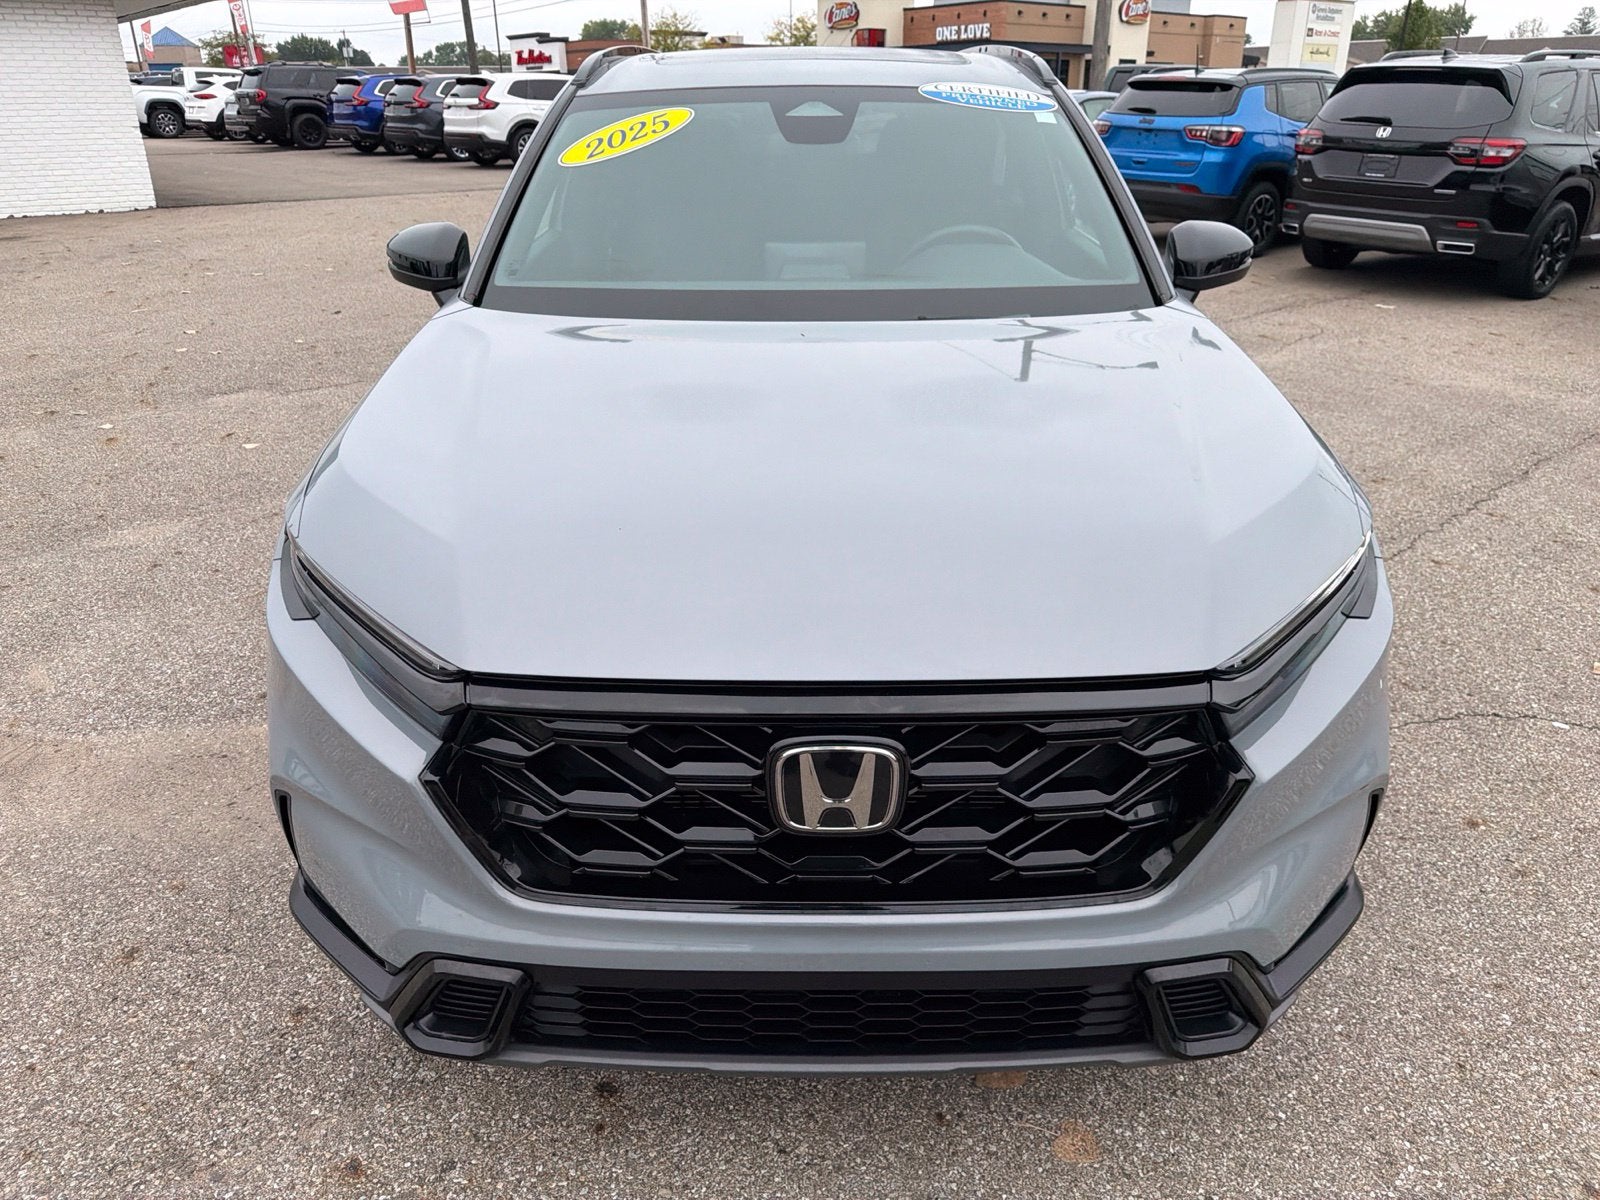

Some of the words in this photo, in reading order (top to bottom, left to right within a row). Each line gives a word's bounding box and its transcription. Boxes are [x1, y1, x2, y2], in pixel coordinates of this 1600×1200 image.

[936, 26, 958, 41] ONE
[960, 23, 990, 39] LOVE
[934, 83, 1040, 101] CERTIFIED
[585, 112, 670, 160] 2025
